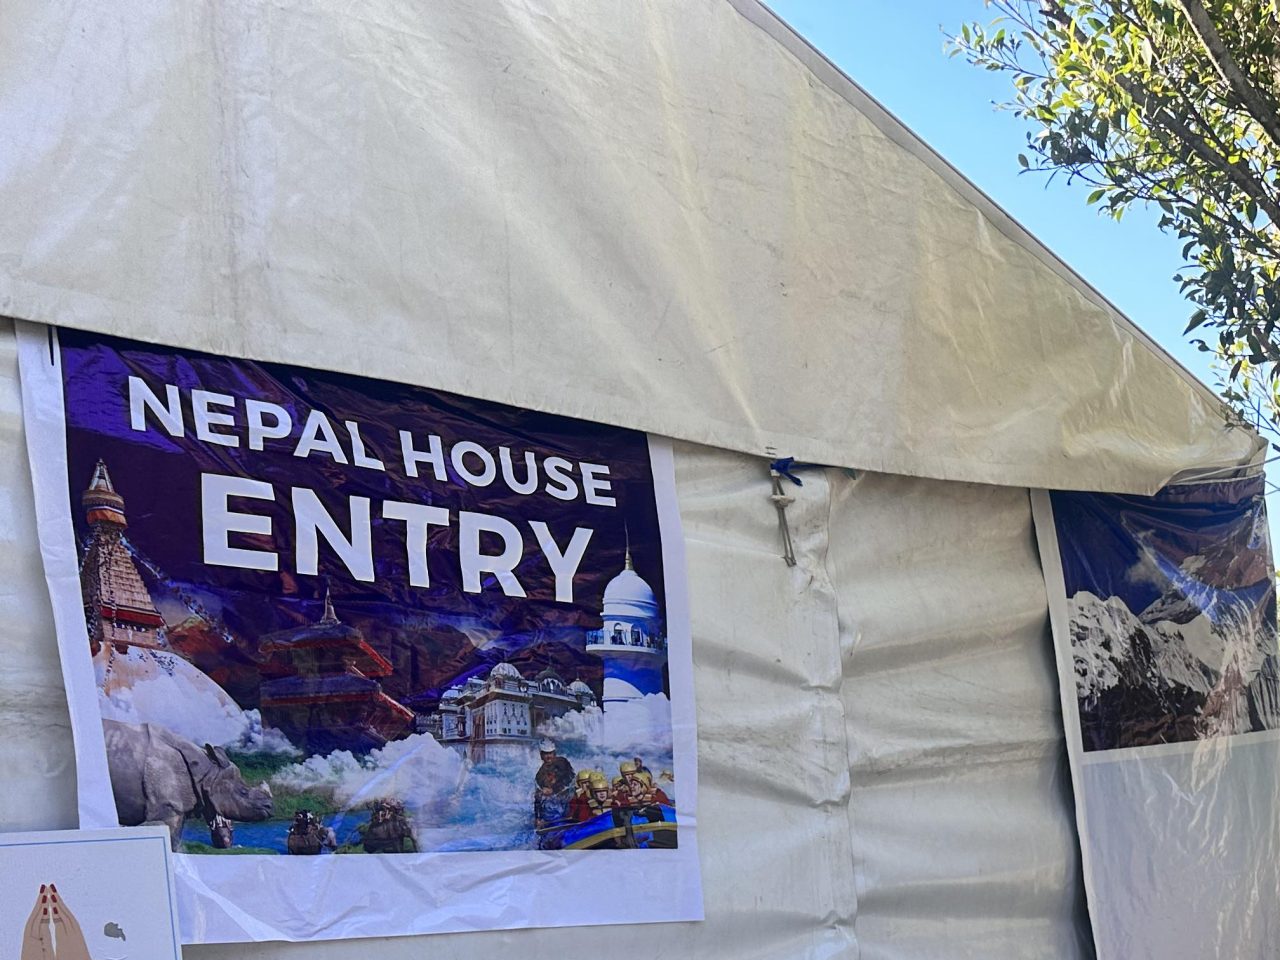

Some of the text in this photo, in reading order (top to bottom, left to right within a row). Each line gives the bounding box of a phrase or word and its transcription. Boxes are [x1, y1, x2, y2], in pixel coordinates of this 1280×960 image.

[128, 375, 617, 507] NEPAL HOUSE
[200, 472, 594, 603] ENTRY
